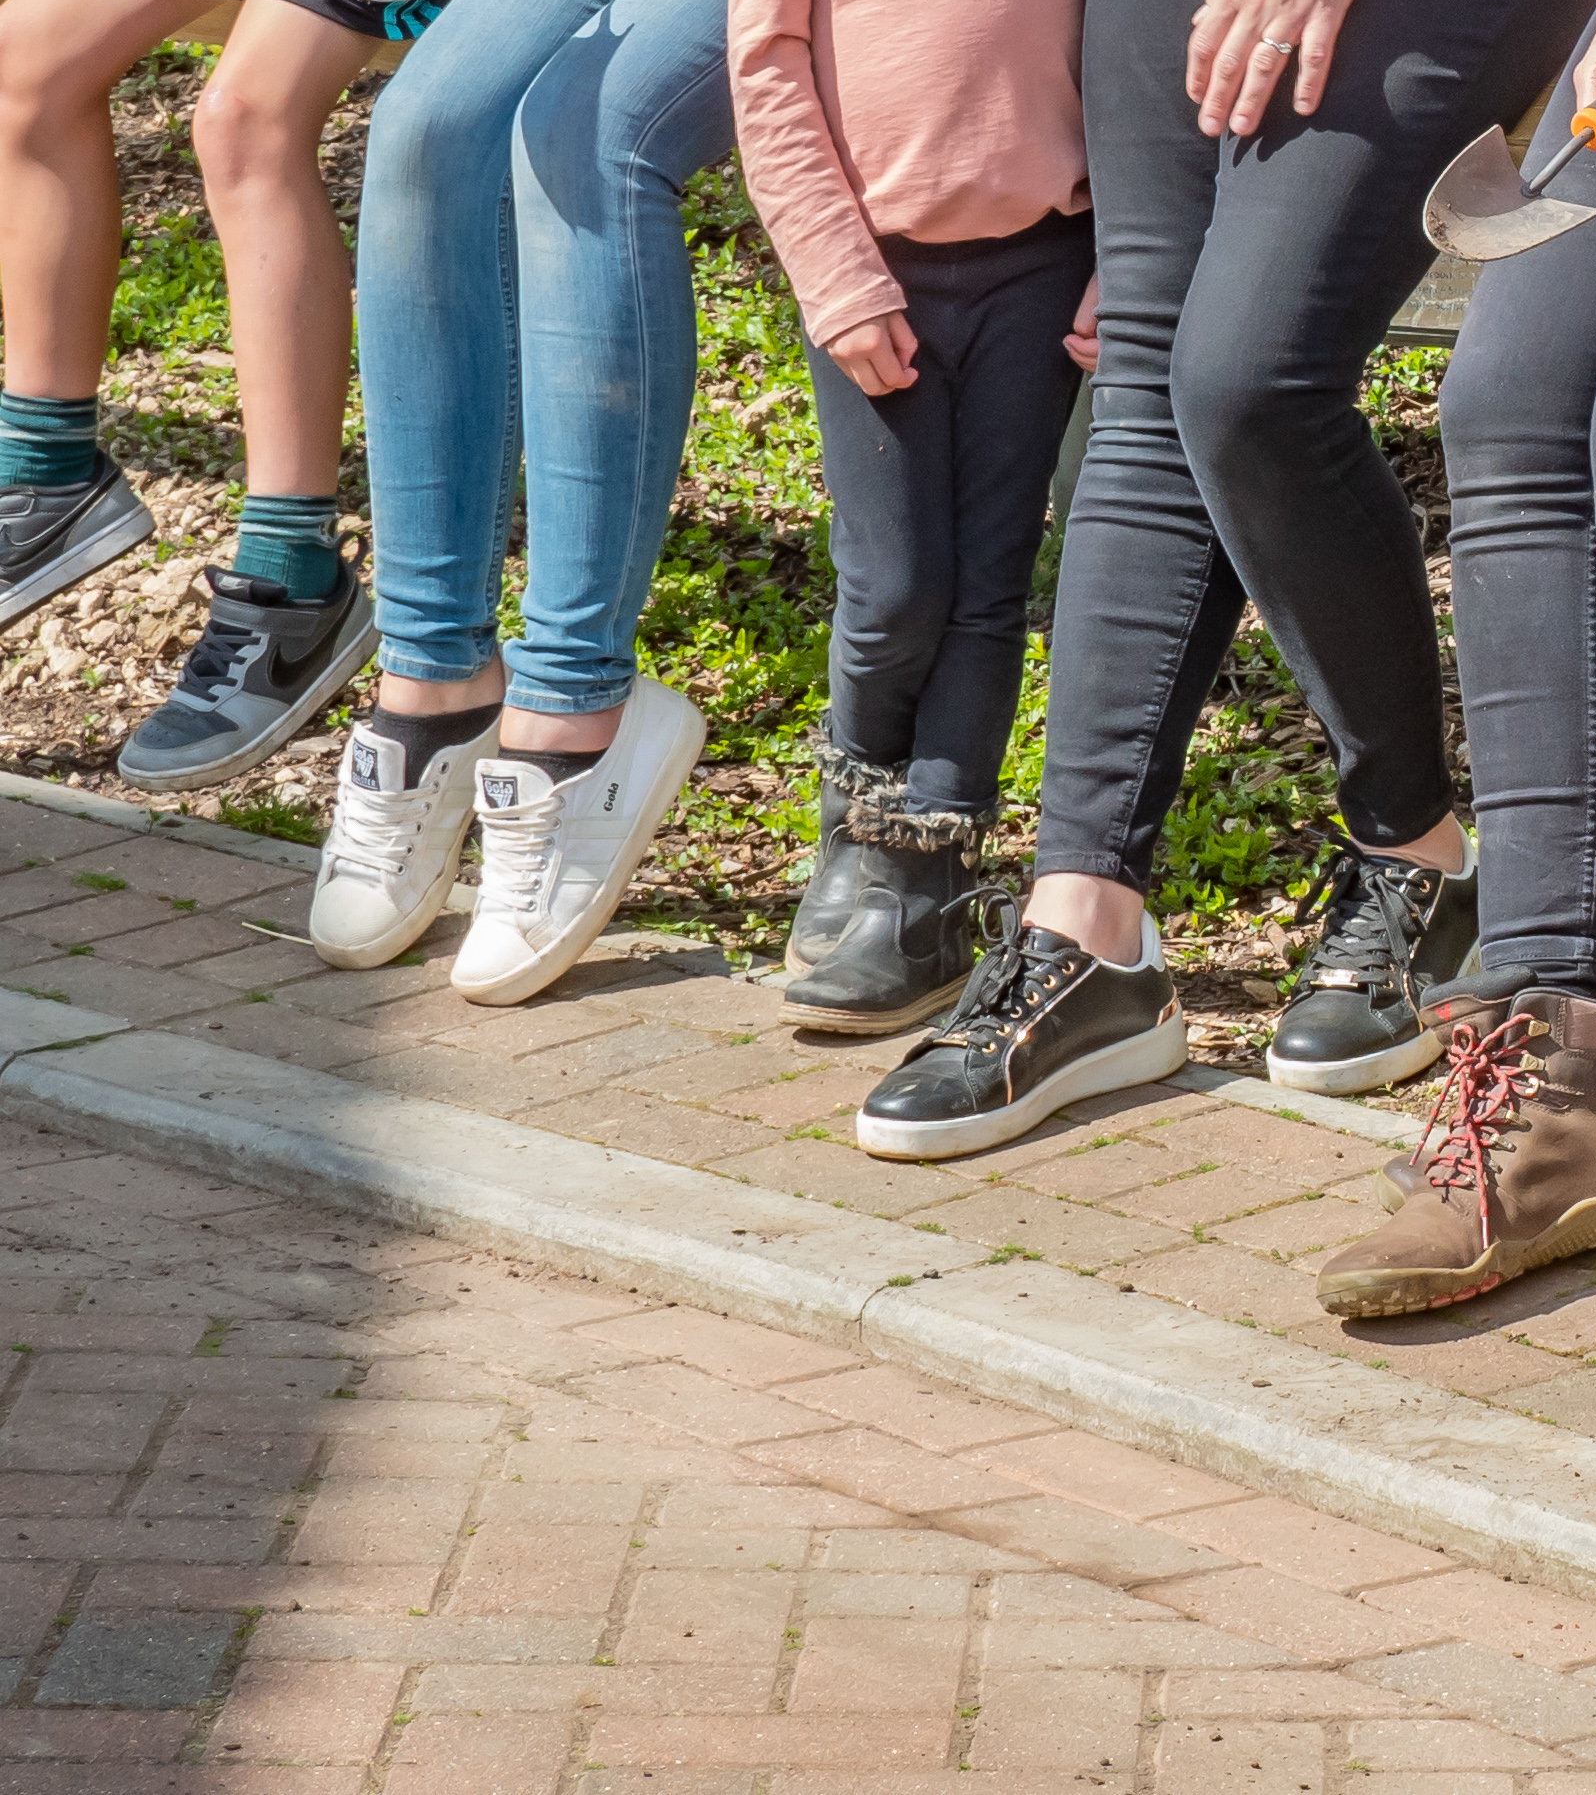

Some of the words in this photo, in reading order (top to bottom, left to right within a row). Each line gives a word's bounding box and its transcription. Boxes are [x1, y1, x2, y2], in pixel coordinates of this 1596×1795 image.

[353, 745, 375, 765] Gola
[484, 778, 514, 795] Gola
[603, 782, 620, 812] Gola
